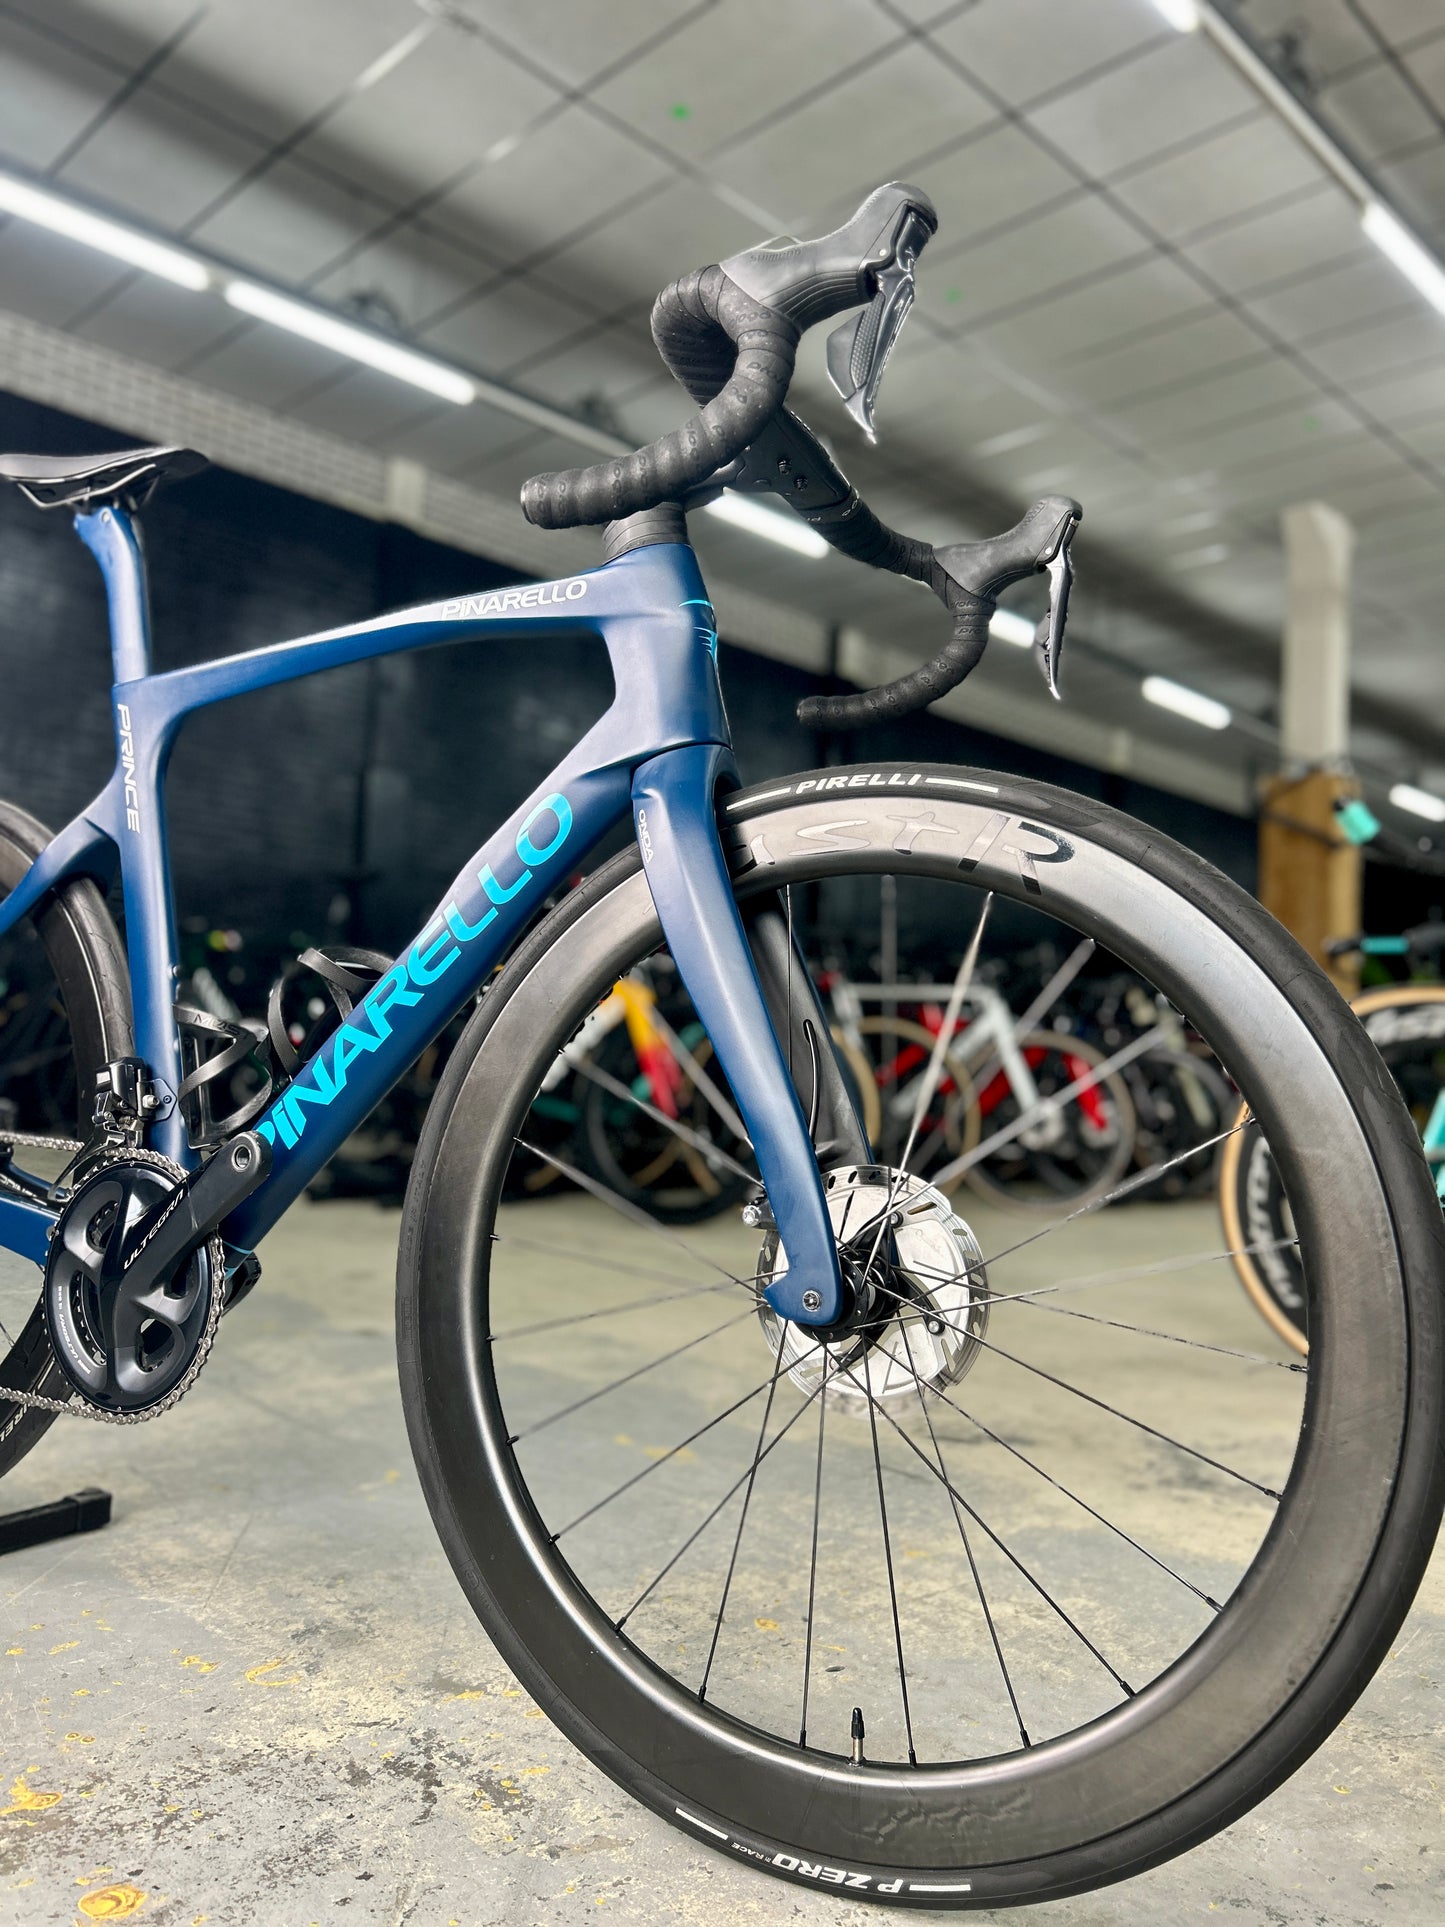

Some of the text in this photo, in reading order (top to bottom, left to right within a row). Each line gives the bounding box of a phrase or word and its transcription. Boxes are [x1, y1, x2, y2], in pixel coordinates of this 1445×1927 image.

[441, 579, 588, 620] PINARELLO
[117, 703, 141, 834] PRINCE
[795, 773, 921, 794] PIRELLI
[638, 809, 654, 863] ONDA
[123, 1188, 184, 1270] ULTEGRA
[731, 1842, 904, 1894] P ZERO RACE
